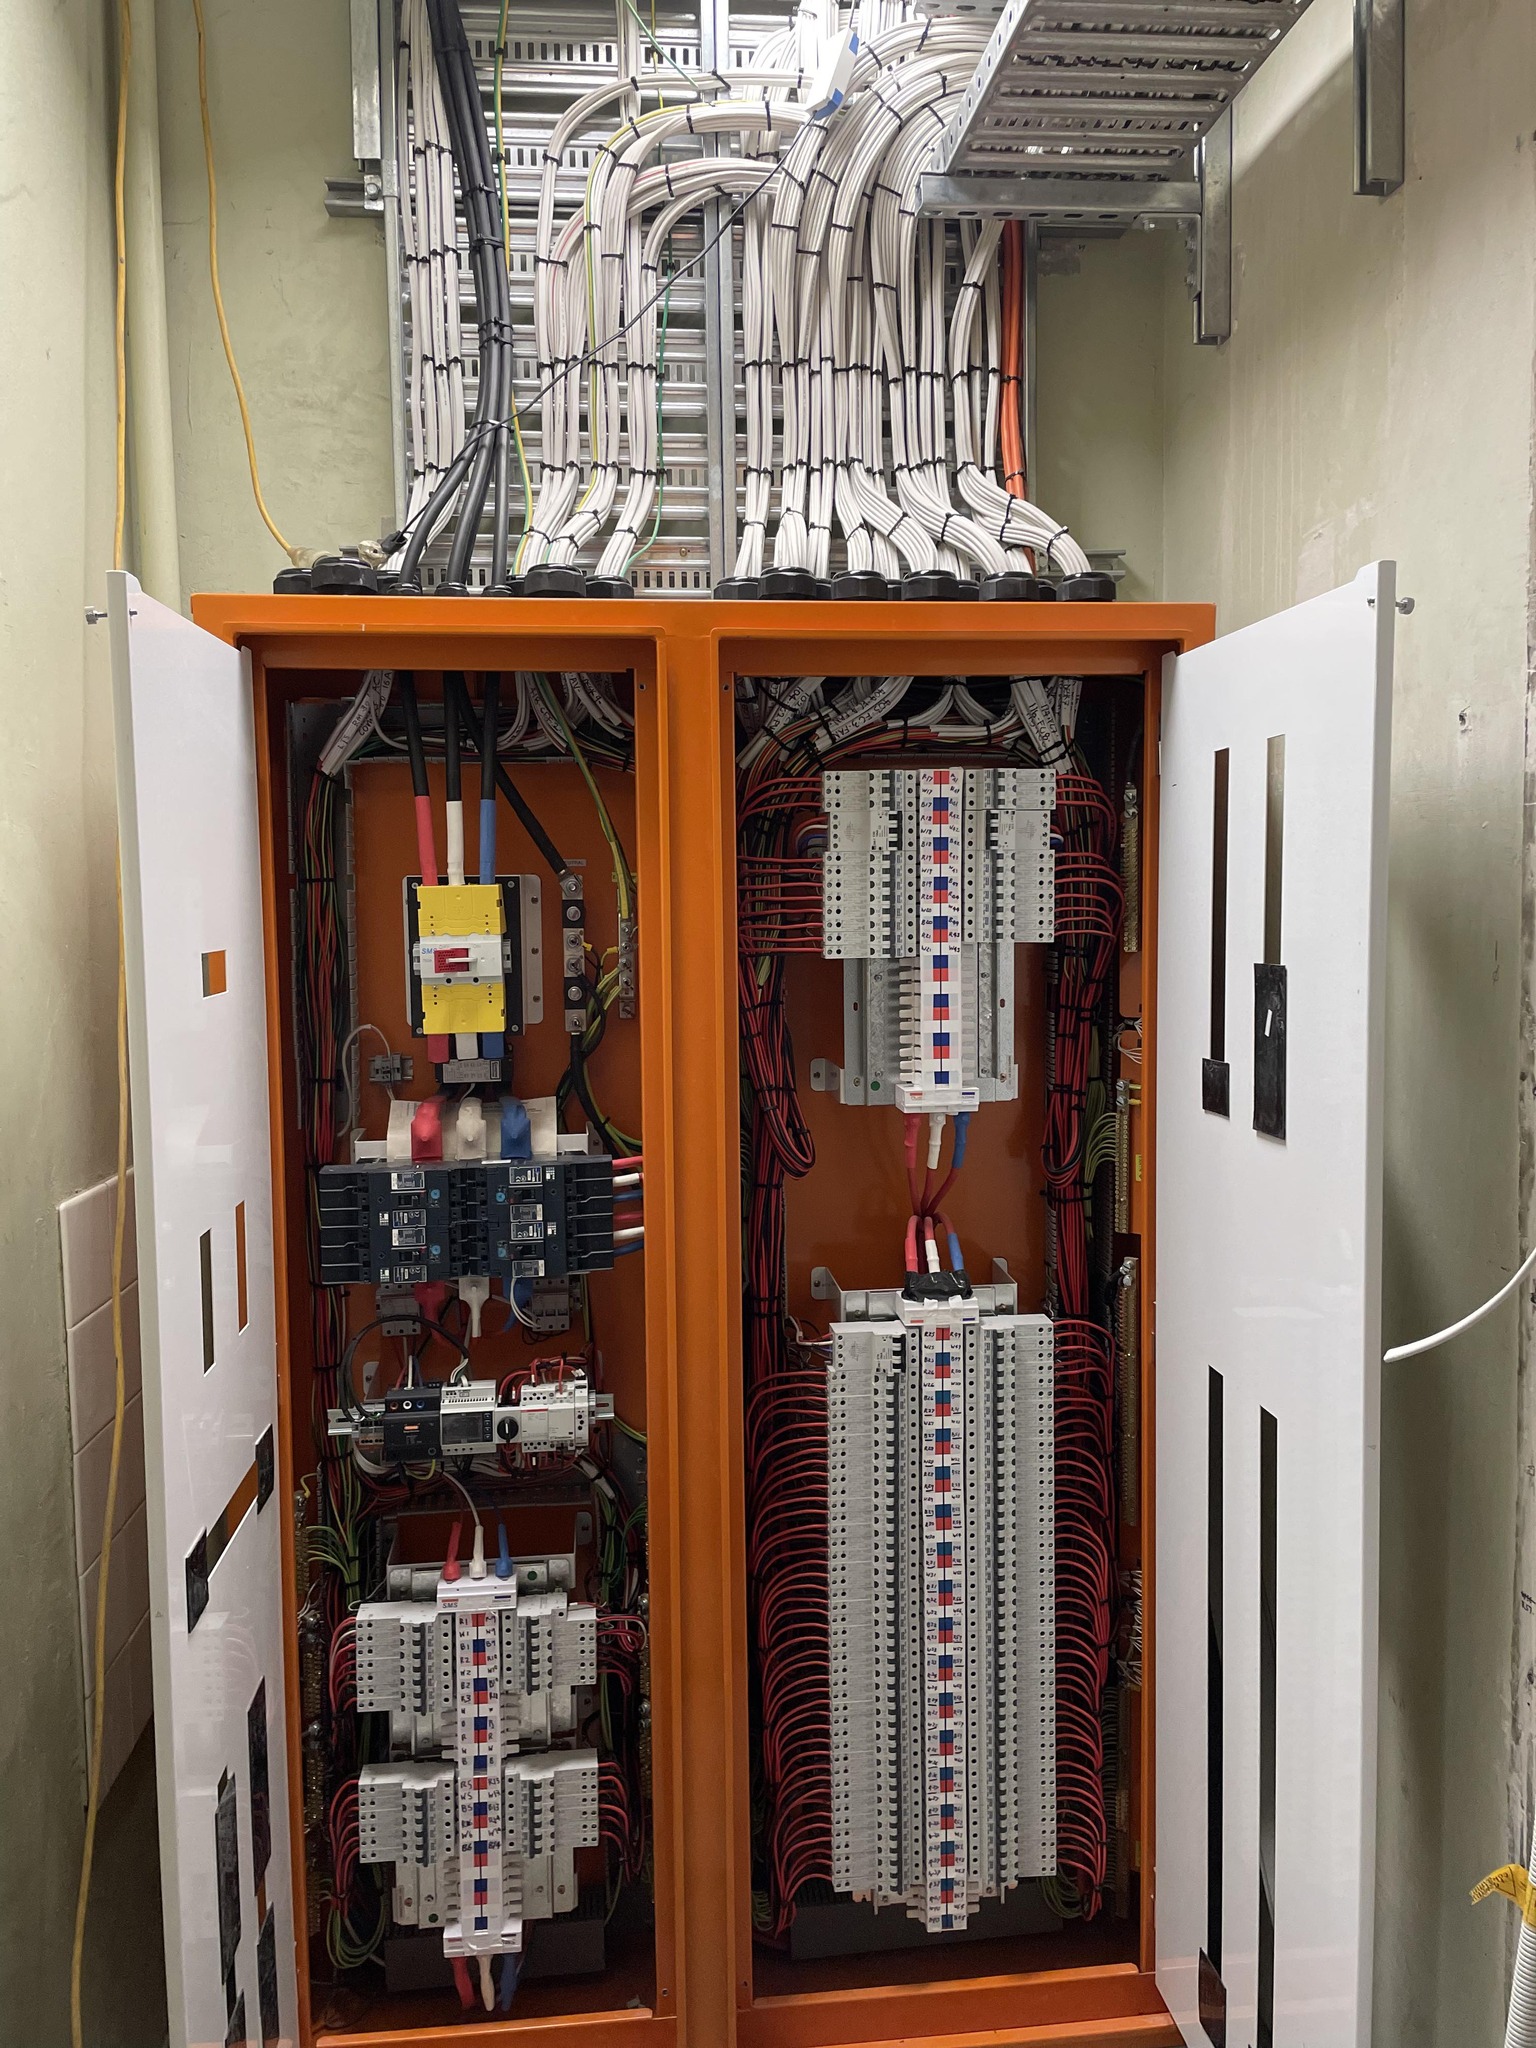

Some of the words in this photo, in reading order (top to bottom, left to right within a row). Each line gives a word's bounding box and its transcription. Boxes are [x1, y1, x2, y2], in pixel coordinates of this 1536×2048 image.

[460, 1780, 472, 1790] R5
[461, 1792, 472, 1800] W5
[461, 1804, 472, 1812] B5
